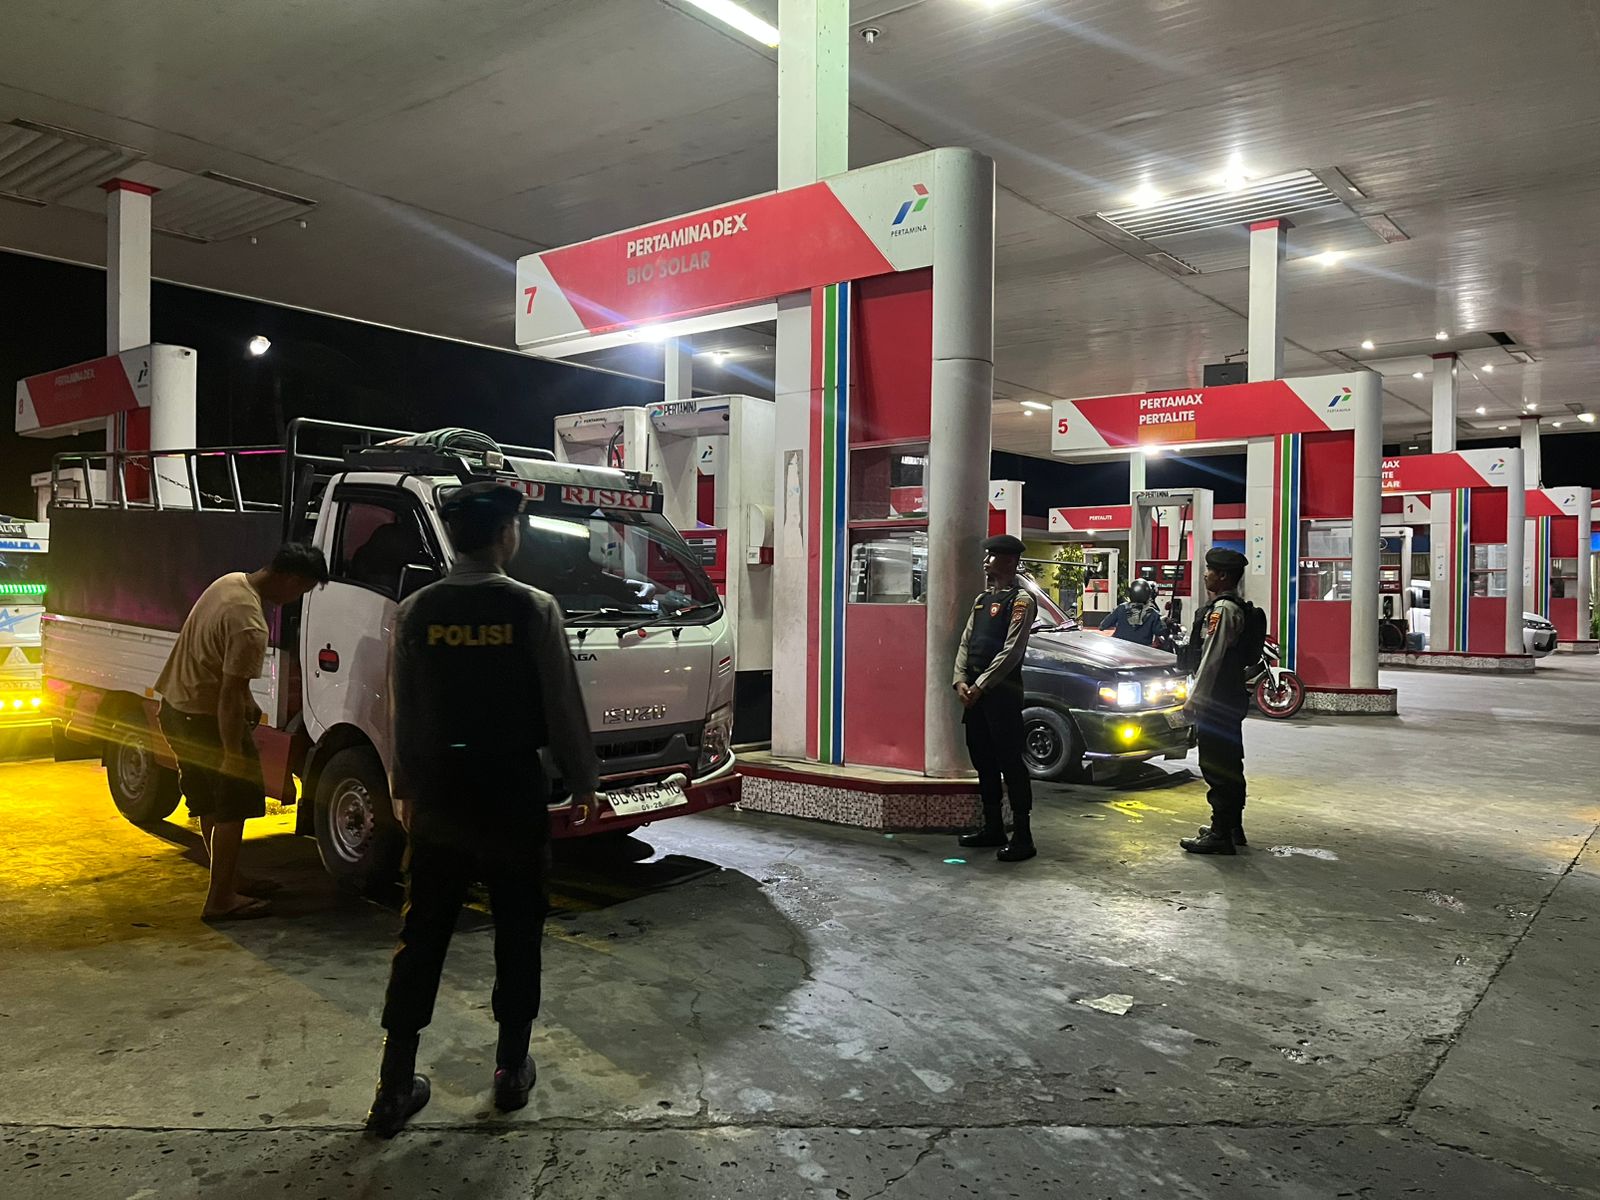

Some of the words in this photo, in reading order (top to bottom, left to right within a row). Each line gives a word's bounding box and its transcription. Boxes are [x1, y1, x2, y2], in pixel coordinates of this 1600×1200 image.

[891, 225, 927, 237] PERTAMINA
[626, 264, 654, 286] BIO
[659, 251, 711, 279] SOLAR
[524, 287, 537, 314] 7
[664, 401, 697, 416] PERTAMINA
[1140, 394, 1203, 410] PERTAMAX
[1139, 410, 1195, 425] PERTALITE
[1058, 418, 1068, 434] 5
[564, 486, 649, 509] RISKI
[1407, 504, 1414, 513] 1
[1052, 516, 1057, 524] 2
[427, 624, 513, 646] POLISI
[603, 705, 666, 724] ISUZU
[608, 791, 629, 806] BL
[629, 785, 660, 803] 8343
